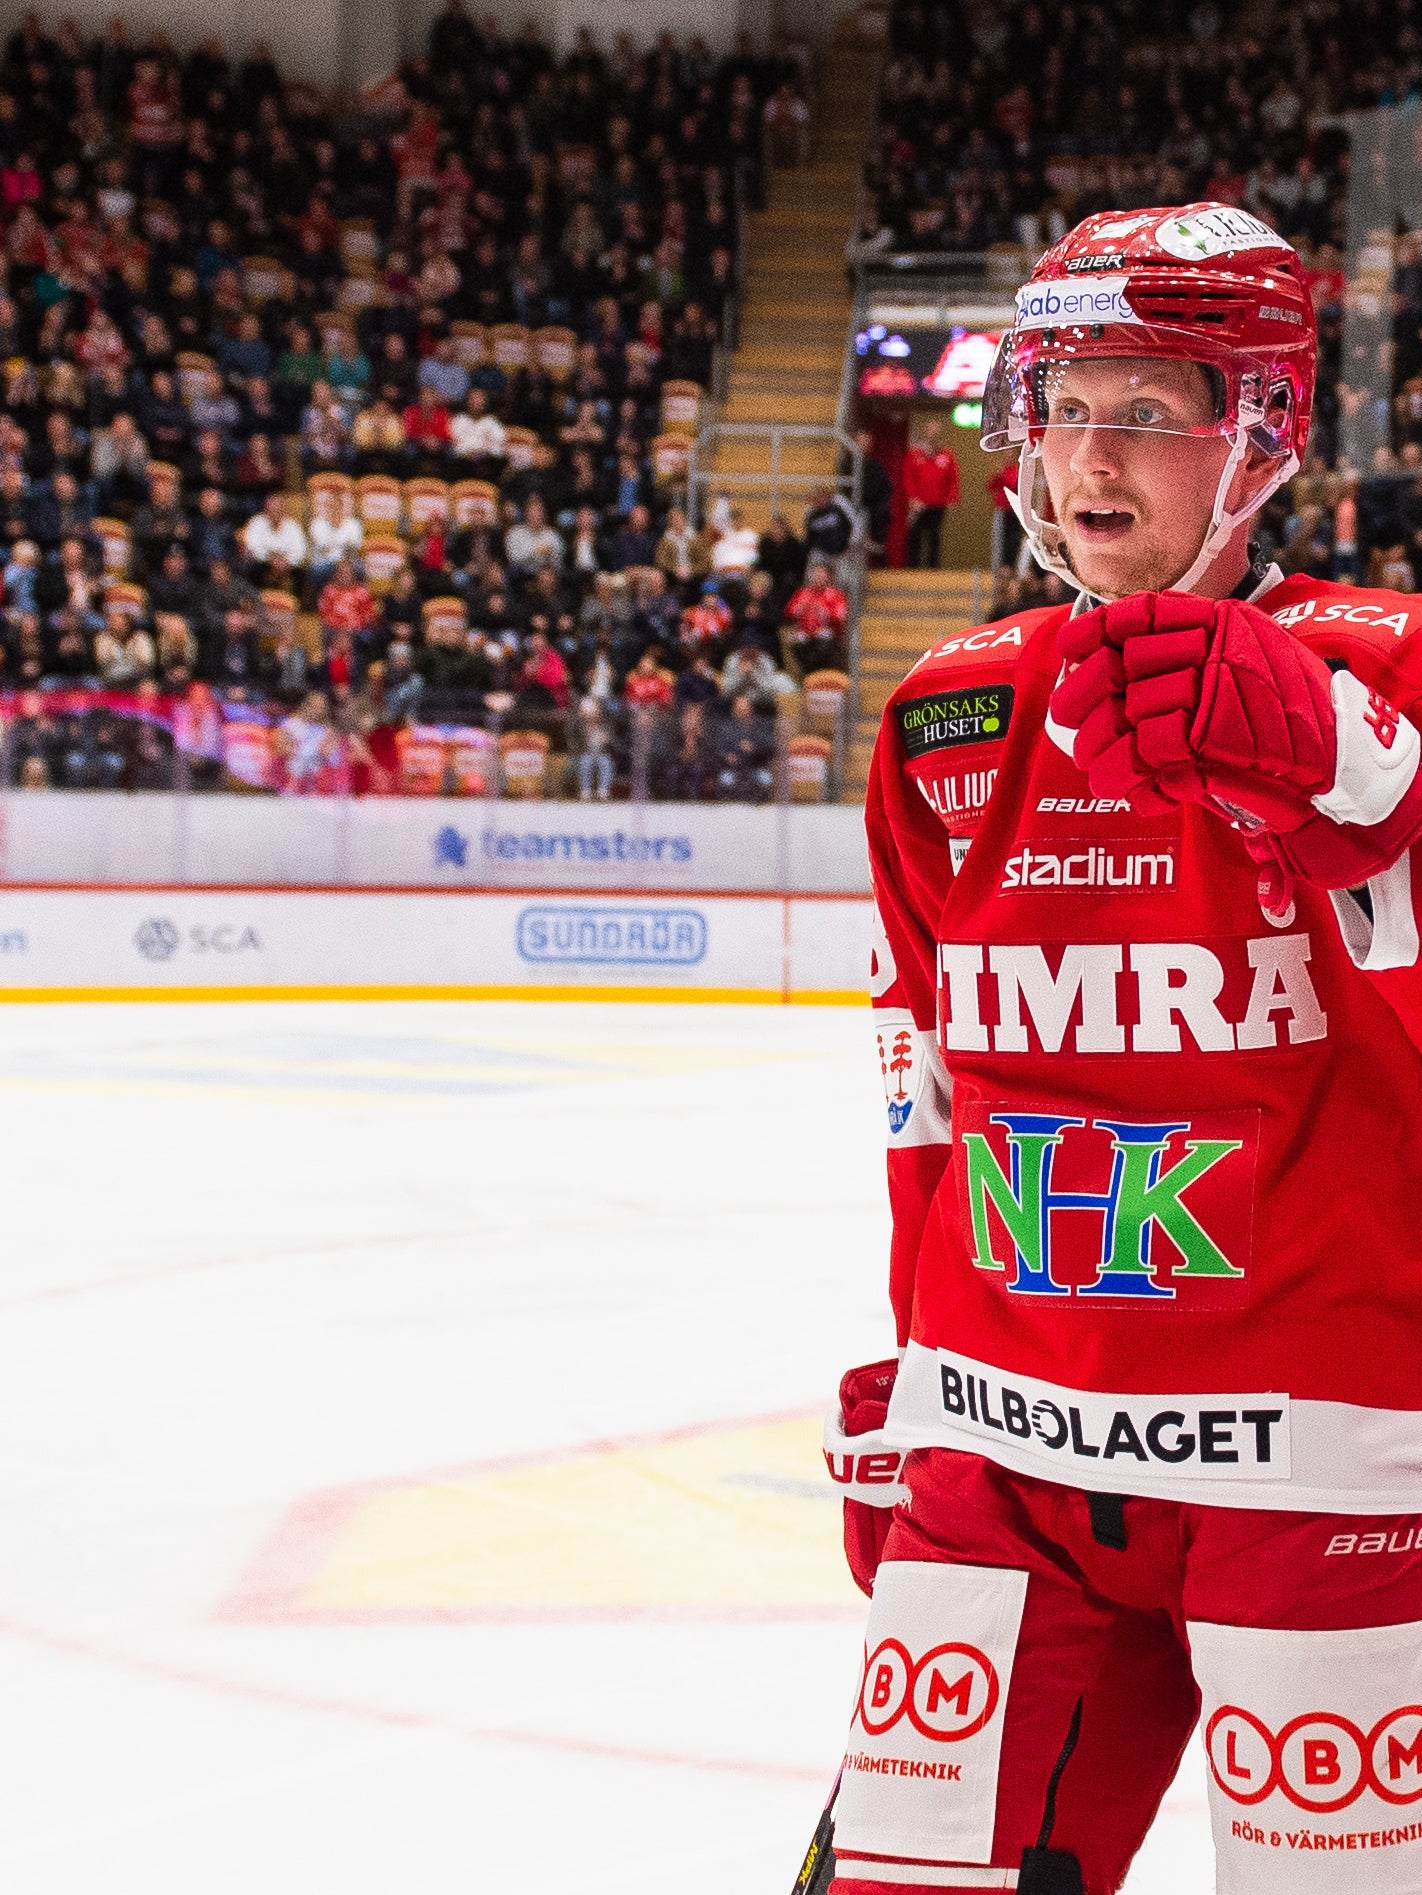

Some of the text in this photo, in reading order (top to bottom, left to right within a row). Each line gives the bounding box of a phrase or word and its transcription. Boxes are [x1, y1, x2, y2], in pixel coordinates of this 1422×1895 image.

[1313, 604, 1410, 637] SCA
[933, 626, 1022, 658] SCA
[903, 694, 999, 730] GRÖNSAKS
[923, 715, 984, 744] HUSET
[1001, 846, 1174, 889] stadium
[189, 925, 262, 954] SCA
[936, 897, 1328, 1054] IMRÅ
[961, 1113, 1247, 1300] NHK
[940, 1363, 1284, 1464] BILBOLAGET
[1231, 1820, 1266, 1846] RÖR
[1270, 1831, 1282, 1847] &
